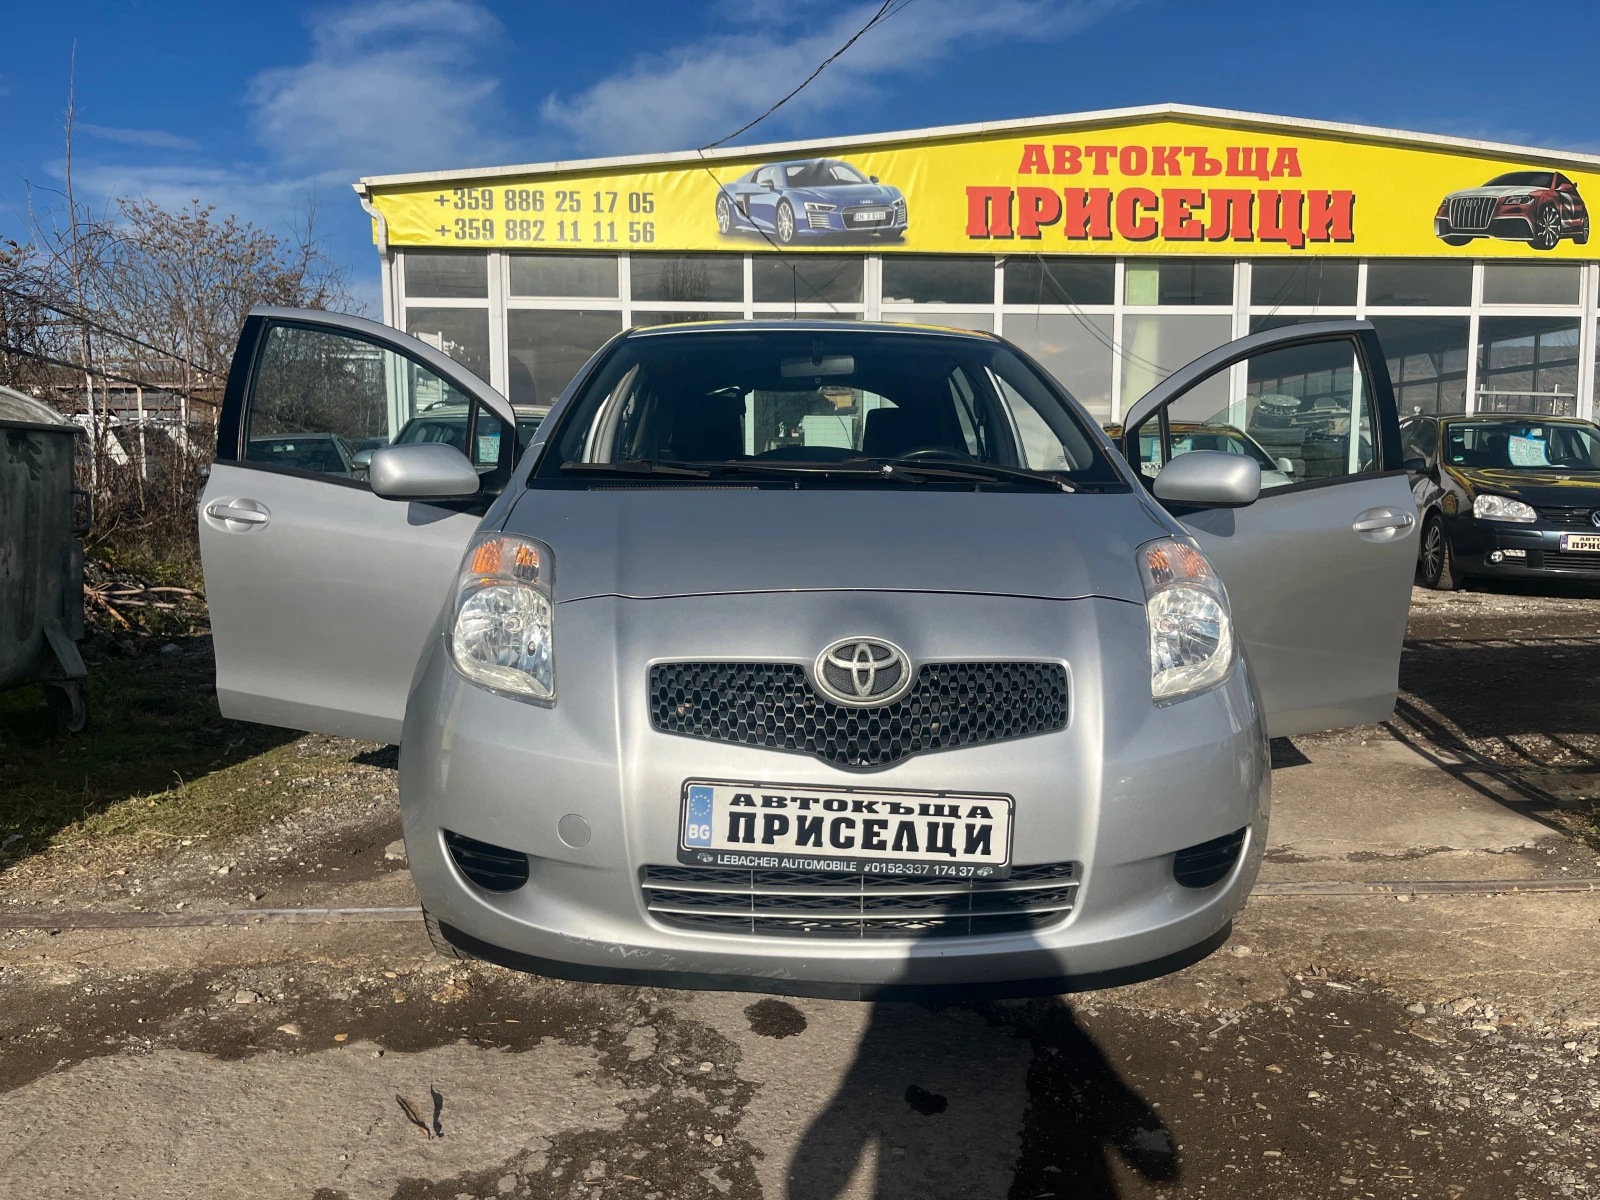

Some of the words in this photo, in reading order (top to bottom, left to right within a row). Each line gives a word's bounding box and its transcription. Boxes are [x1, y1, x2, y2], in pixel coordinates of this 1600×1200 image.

[1018, 144, 1302, 181] АВТОКЪЩА
[434, 188, 494, 211] +359
[504, 189, 545, 212] 886
[555, 190, 581, 213] 25
[593, 191, 618, 213] 17
[628, 192, 654, 214] 05
[435, 218, 495, 240] +359
[505, 219, 545, 242] 882
[556, 220, 582, 242] 11
[593, 221, 618, 243] 11
[629, 221, 655, 243] 56
[965, 186, 1356, 249] ПРИСЕЛЦИ
[729, 793, 993, 819] АВТОКЪЩА
[688, 823, 710, 840] BG
[727, 811, 993, 857] ПРИСЕЛЦИ
[717, 854, 779, 868] LEBACHER
[781, 857, 857, 871] AUTOMOBILE
[871, 862, 929, 874] 0152-337
[933, 865, 956, 876] 174
[959, 866, 974, 876] 37
